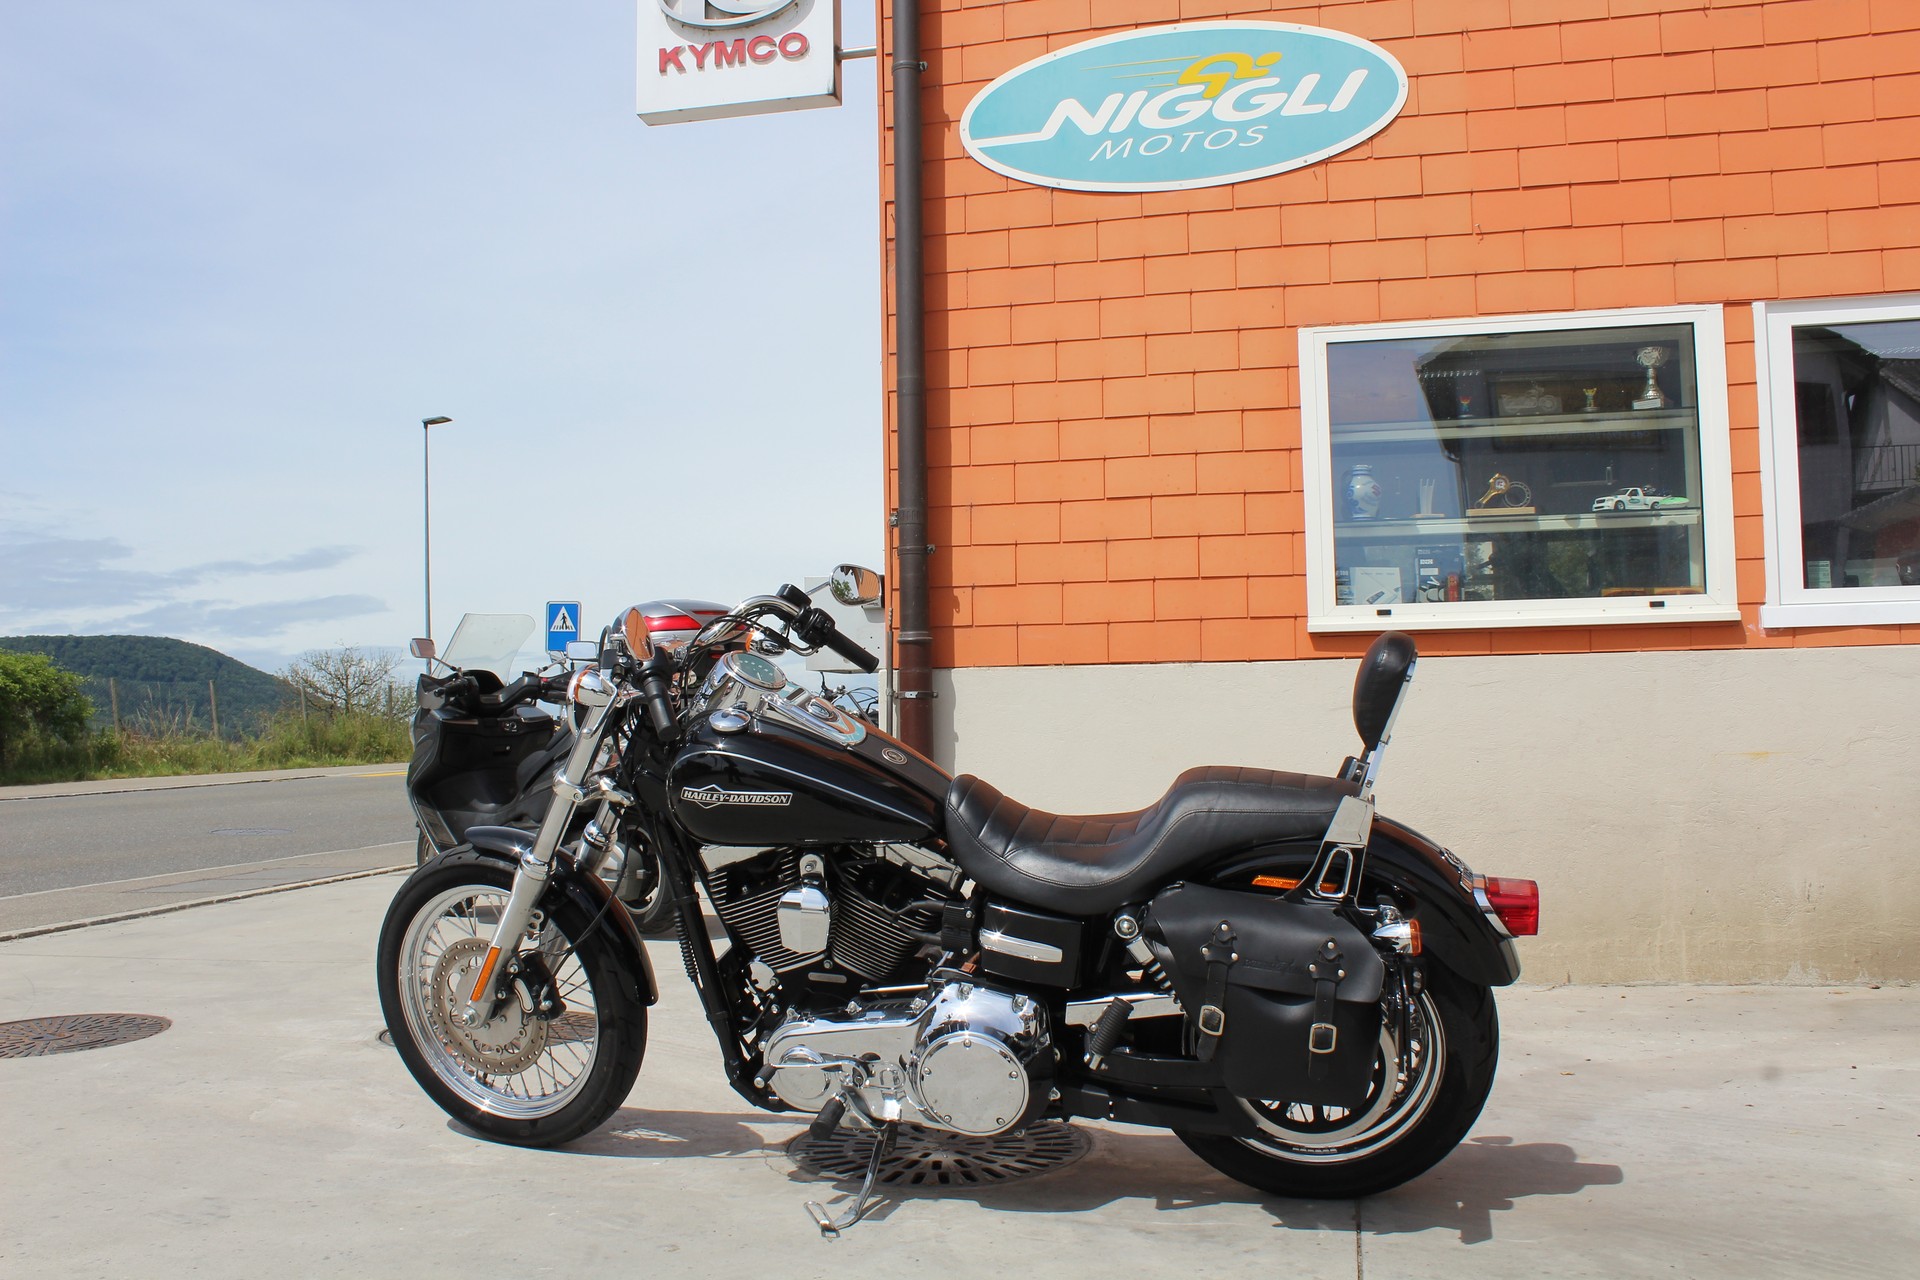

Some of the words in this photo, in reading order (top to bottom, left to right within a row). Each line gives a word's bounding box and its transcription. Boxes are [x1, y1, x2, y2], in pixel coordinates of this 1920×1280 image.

[658, 32, 809, 73] KYMCO
[1036, 68, 1369, 140] NIGGLI
[1088, 125, 1269, 162] MOTOS
[683, 790, 788, 804] HARLEY-DAVIDSON
